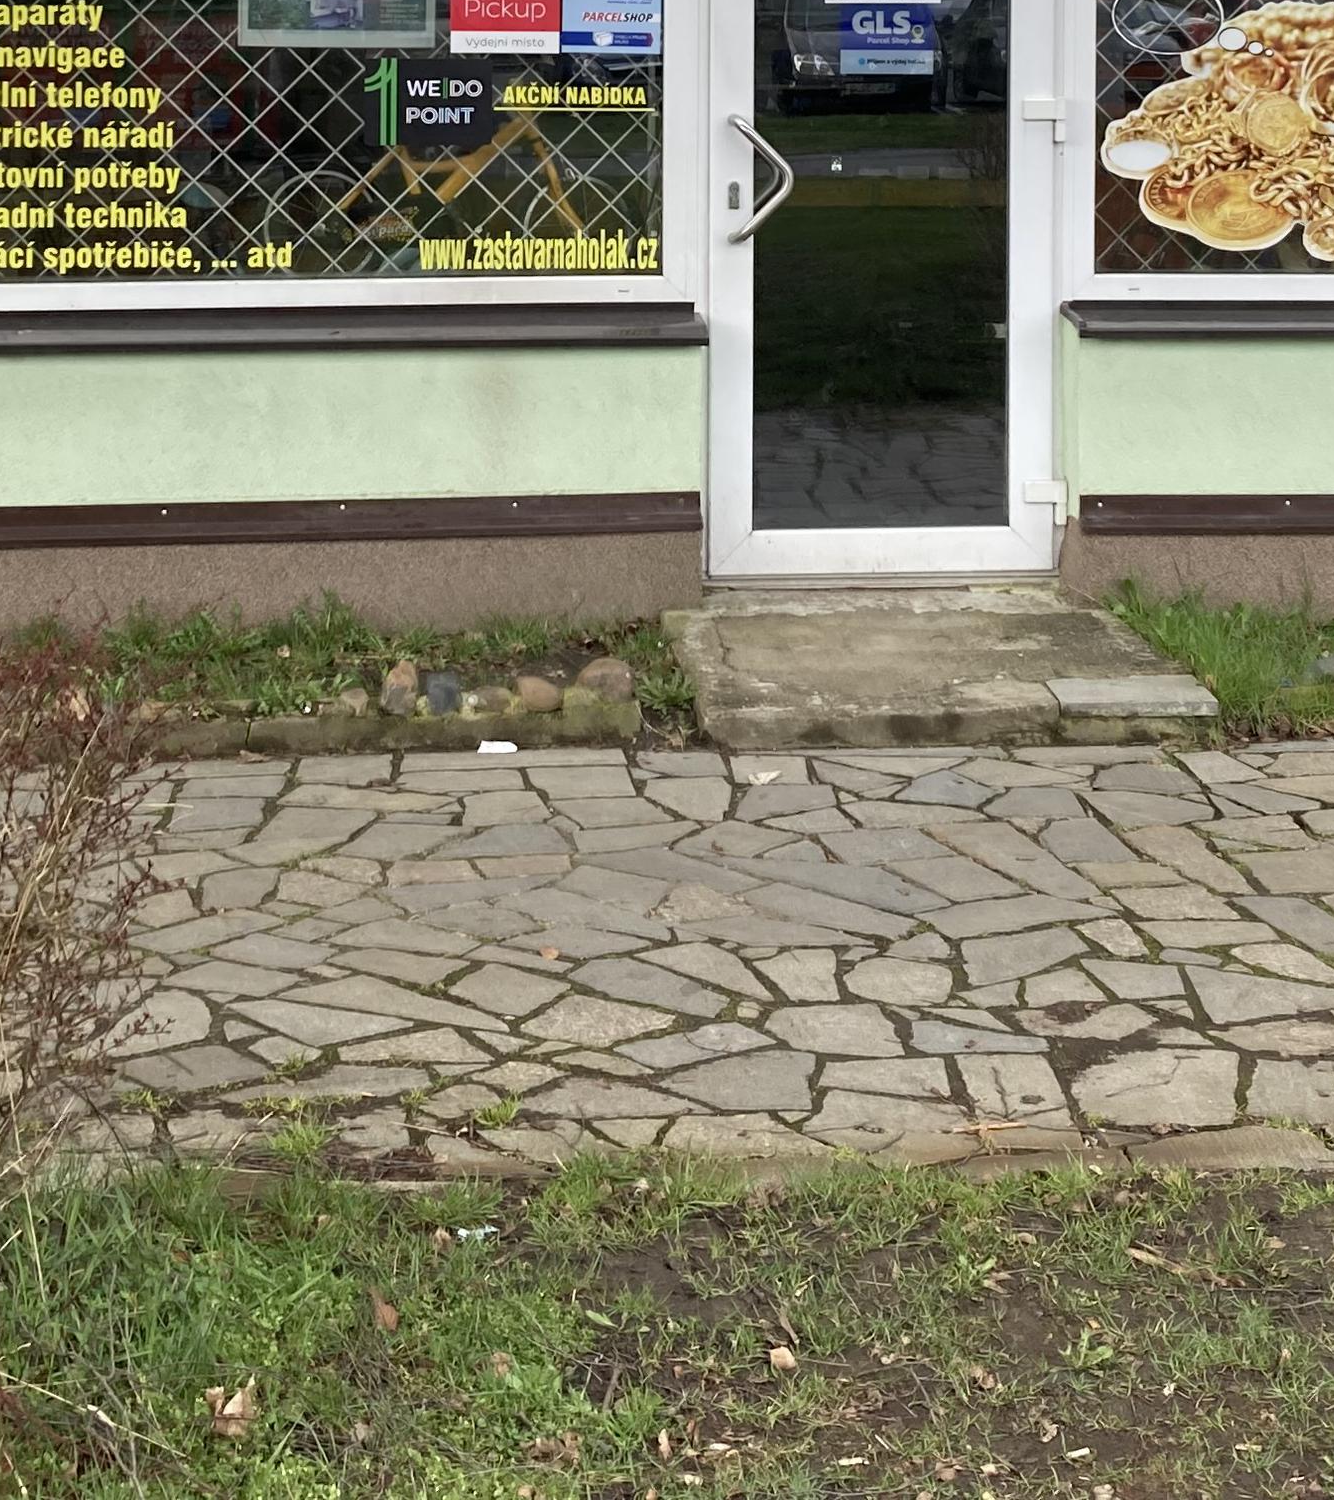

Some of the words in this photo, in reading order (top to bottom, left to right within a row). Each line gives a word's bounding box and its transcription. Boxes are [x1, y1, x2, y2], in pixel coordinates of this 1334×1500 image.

[582, 11, 654, 23] PARCELSHOP
[851, 10, 911, 35] GLS
[511, 36, 545, 48] místo
[892, 37, 910, 46] Shop
[46, 81, 162, 114] telefony
[503, 81, 559, 105] AKČNÍ
[566, 81, 647, 105] NABÍDKA
[405, 106, 475, 125] POINT
[83, 121, 175, 149] nářadí
[74, 160, 181, 194] potřeby
[64, 201, 188, 229] technika
[43, 241, 202, 274] spotřebiče,
[247, 241, 293, 269] atd
[419, 229, 659, 270] www.zastavarnaholak.cz
